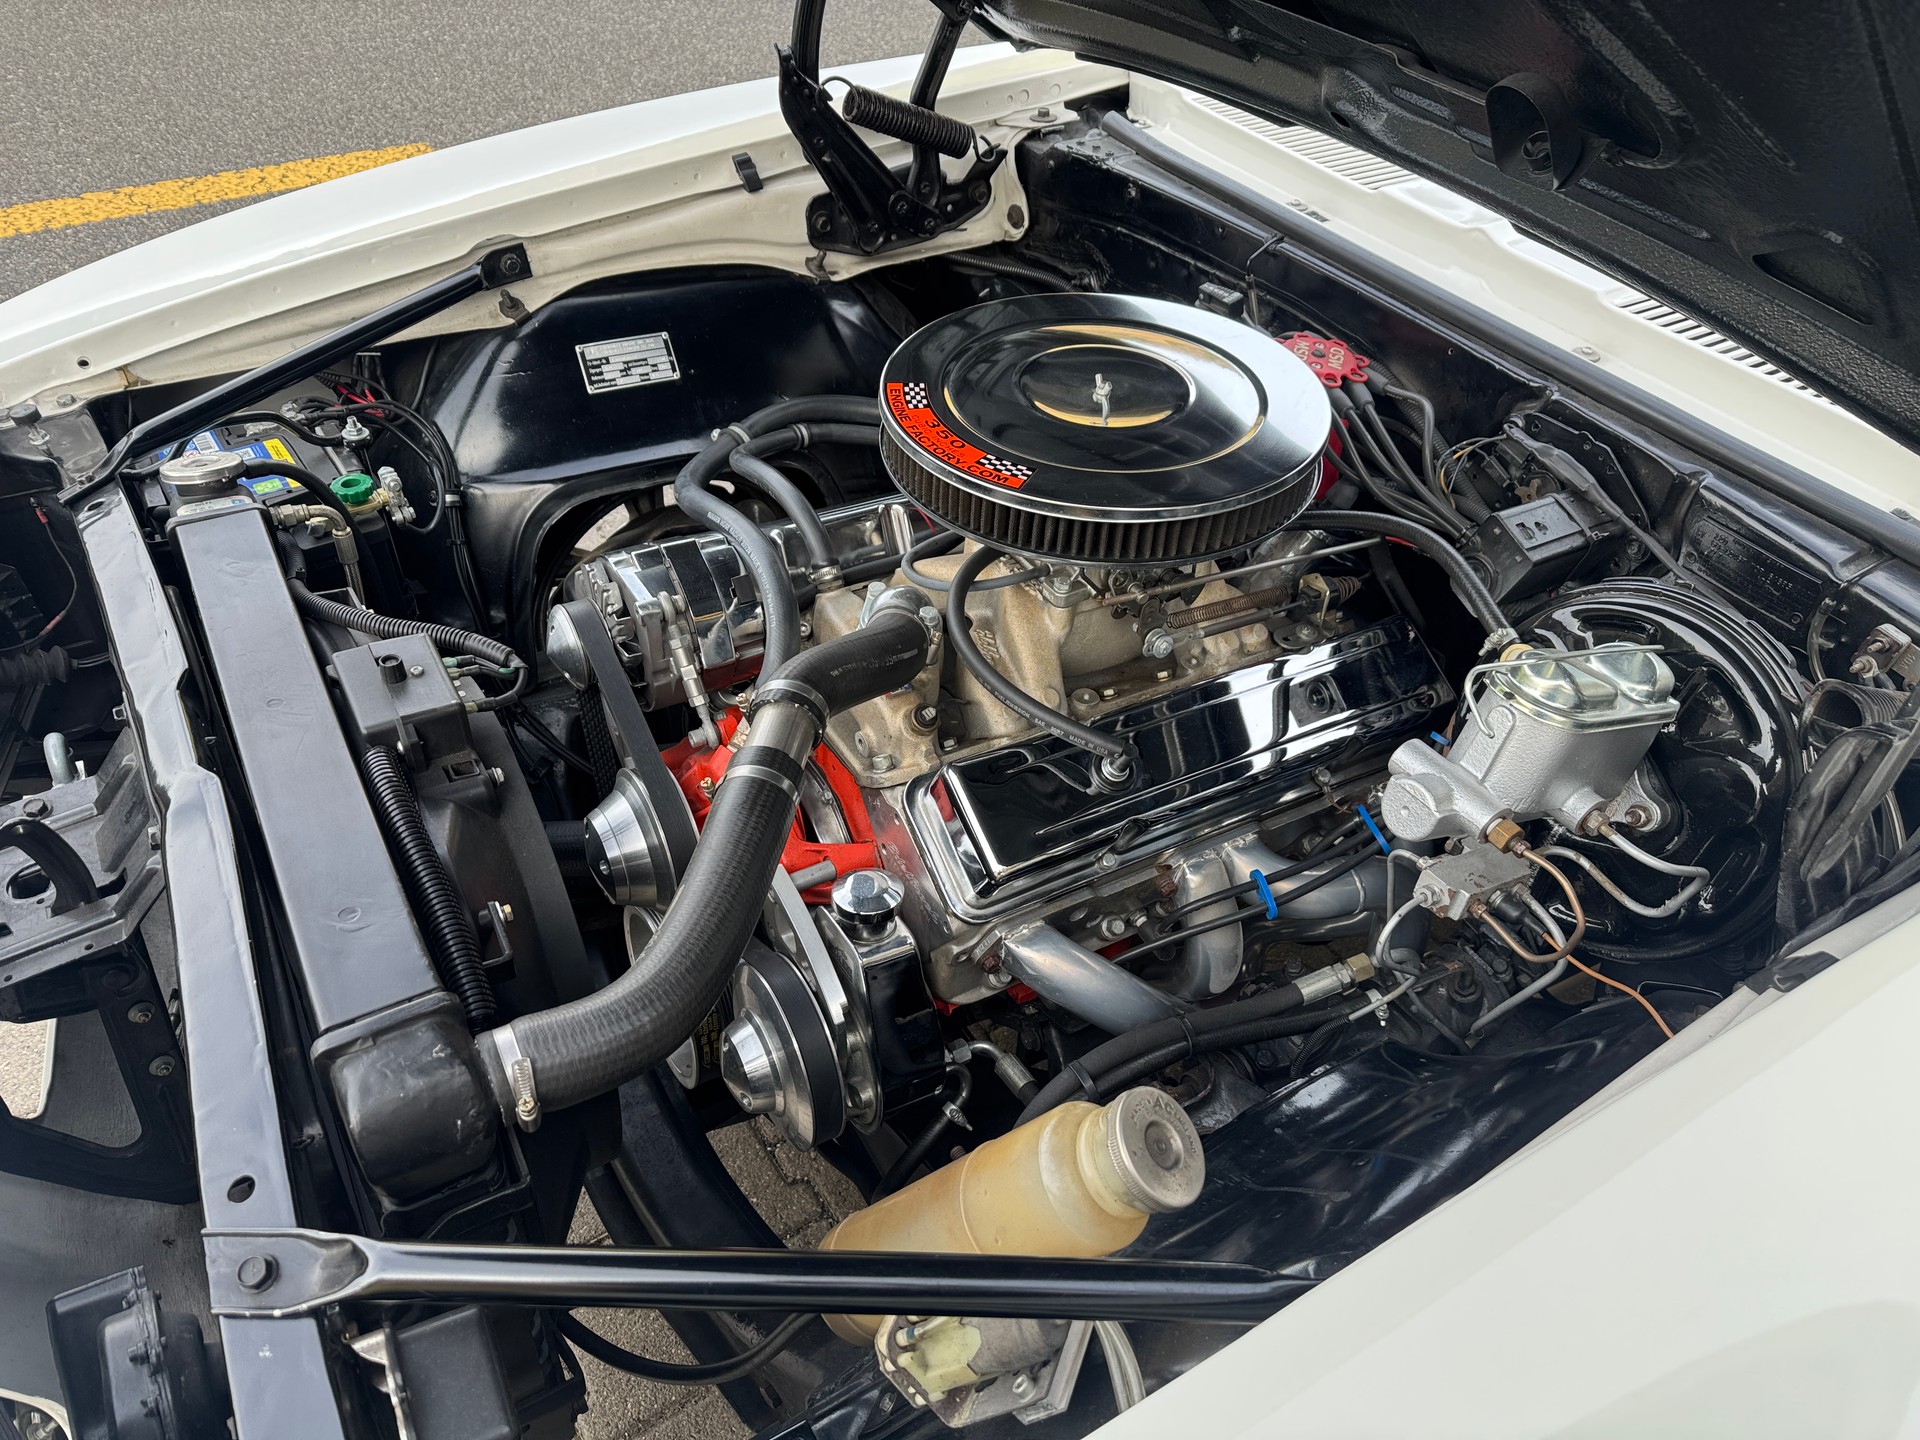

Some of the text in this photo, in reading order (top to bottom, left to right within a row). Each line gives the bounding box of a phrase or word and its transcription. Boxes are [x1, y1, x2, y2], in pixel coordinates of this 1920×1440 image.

[1328, 346, 1345, 370] MSD
[889, 388, 1010, 484] ENGINE FACTORY.COM
[924, 418, 966, 449] 350
[932, 435, 966, 458] INCHES
[1034, 718, 1046, 728] SAE
[1069, 734, 1086, 746] MADE
[1096, 746, 1109, 755] USA
